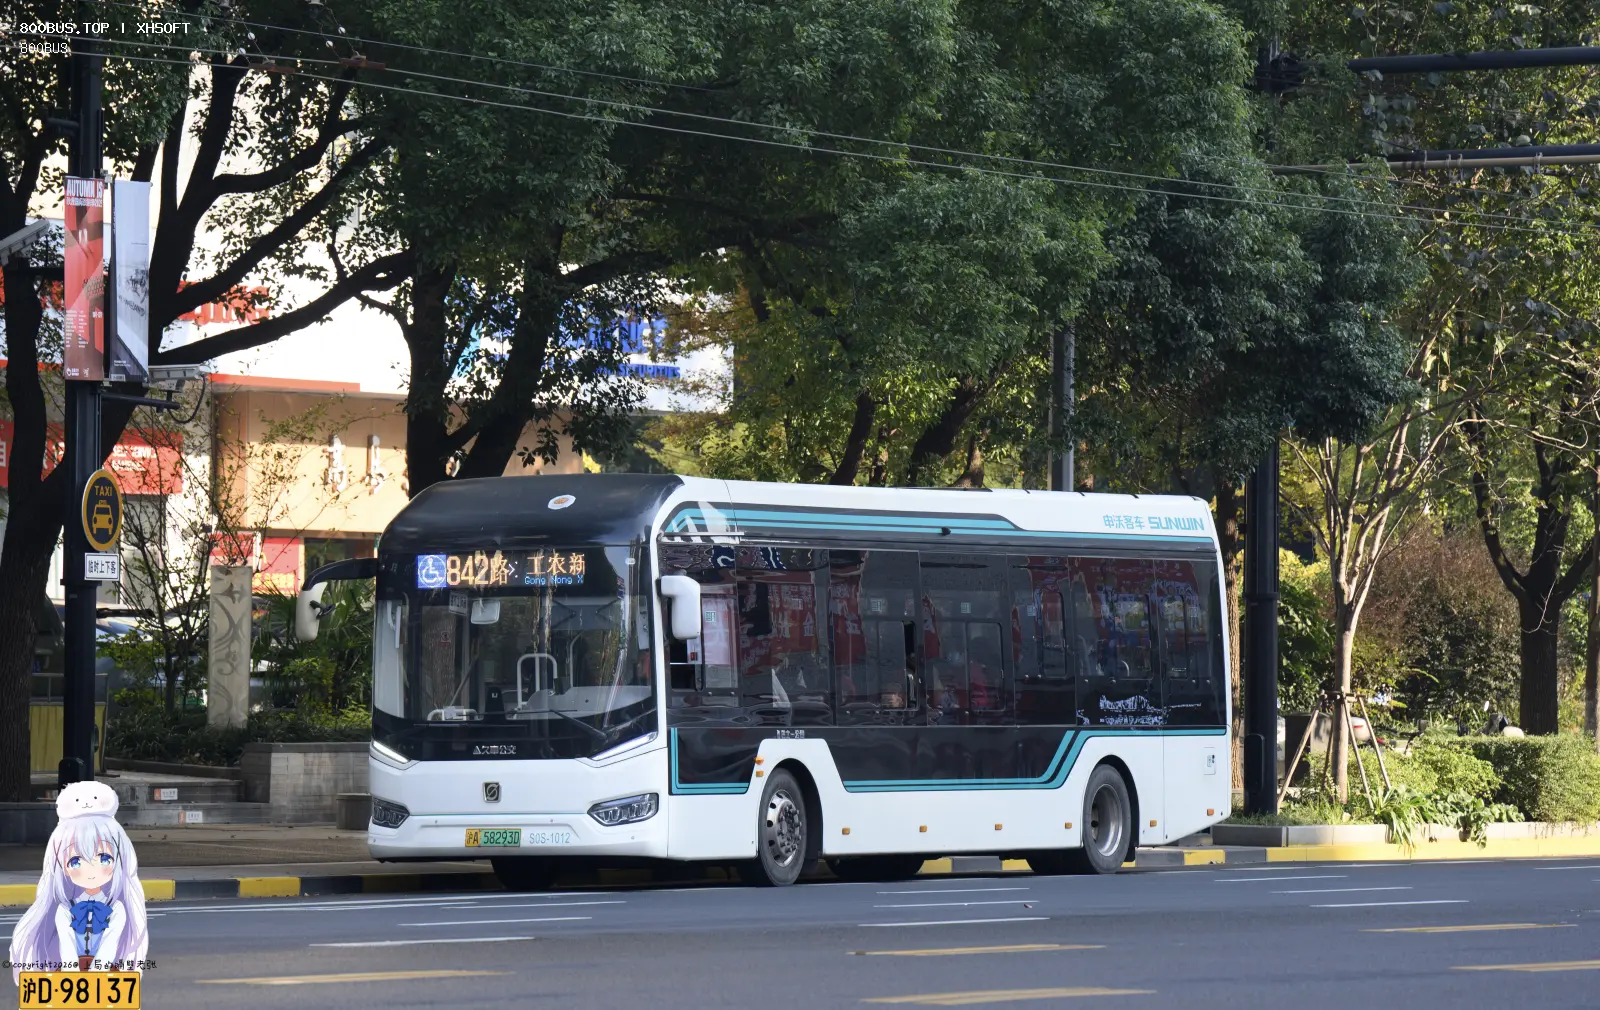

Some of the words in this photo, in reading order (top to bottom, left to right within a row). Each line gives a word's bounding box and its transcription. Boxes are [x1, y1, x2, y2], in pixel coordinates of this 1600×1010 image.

[67, 178, 95, 198] AUTUMN
[96, 181, 103, 199] IS
[95, 485, 113, 497] TAXI
[1102, 514, 1145, 531] 申沃客车
[1147, 516, 1205, 531] SUNWIN
[88, 559, 117, 575] 临时上下客
[446, 555, 509, 586] 842路
[527, 552, 586, 576] 工农新
[524, 576, 546, 586] Gong
